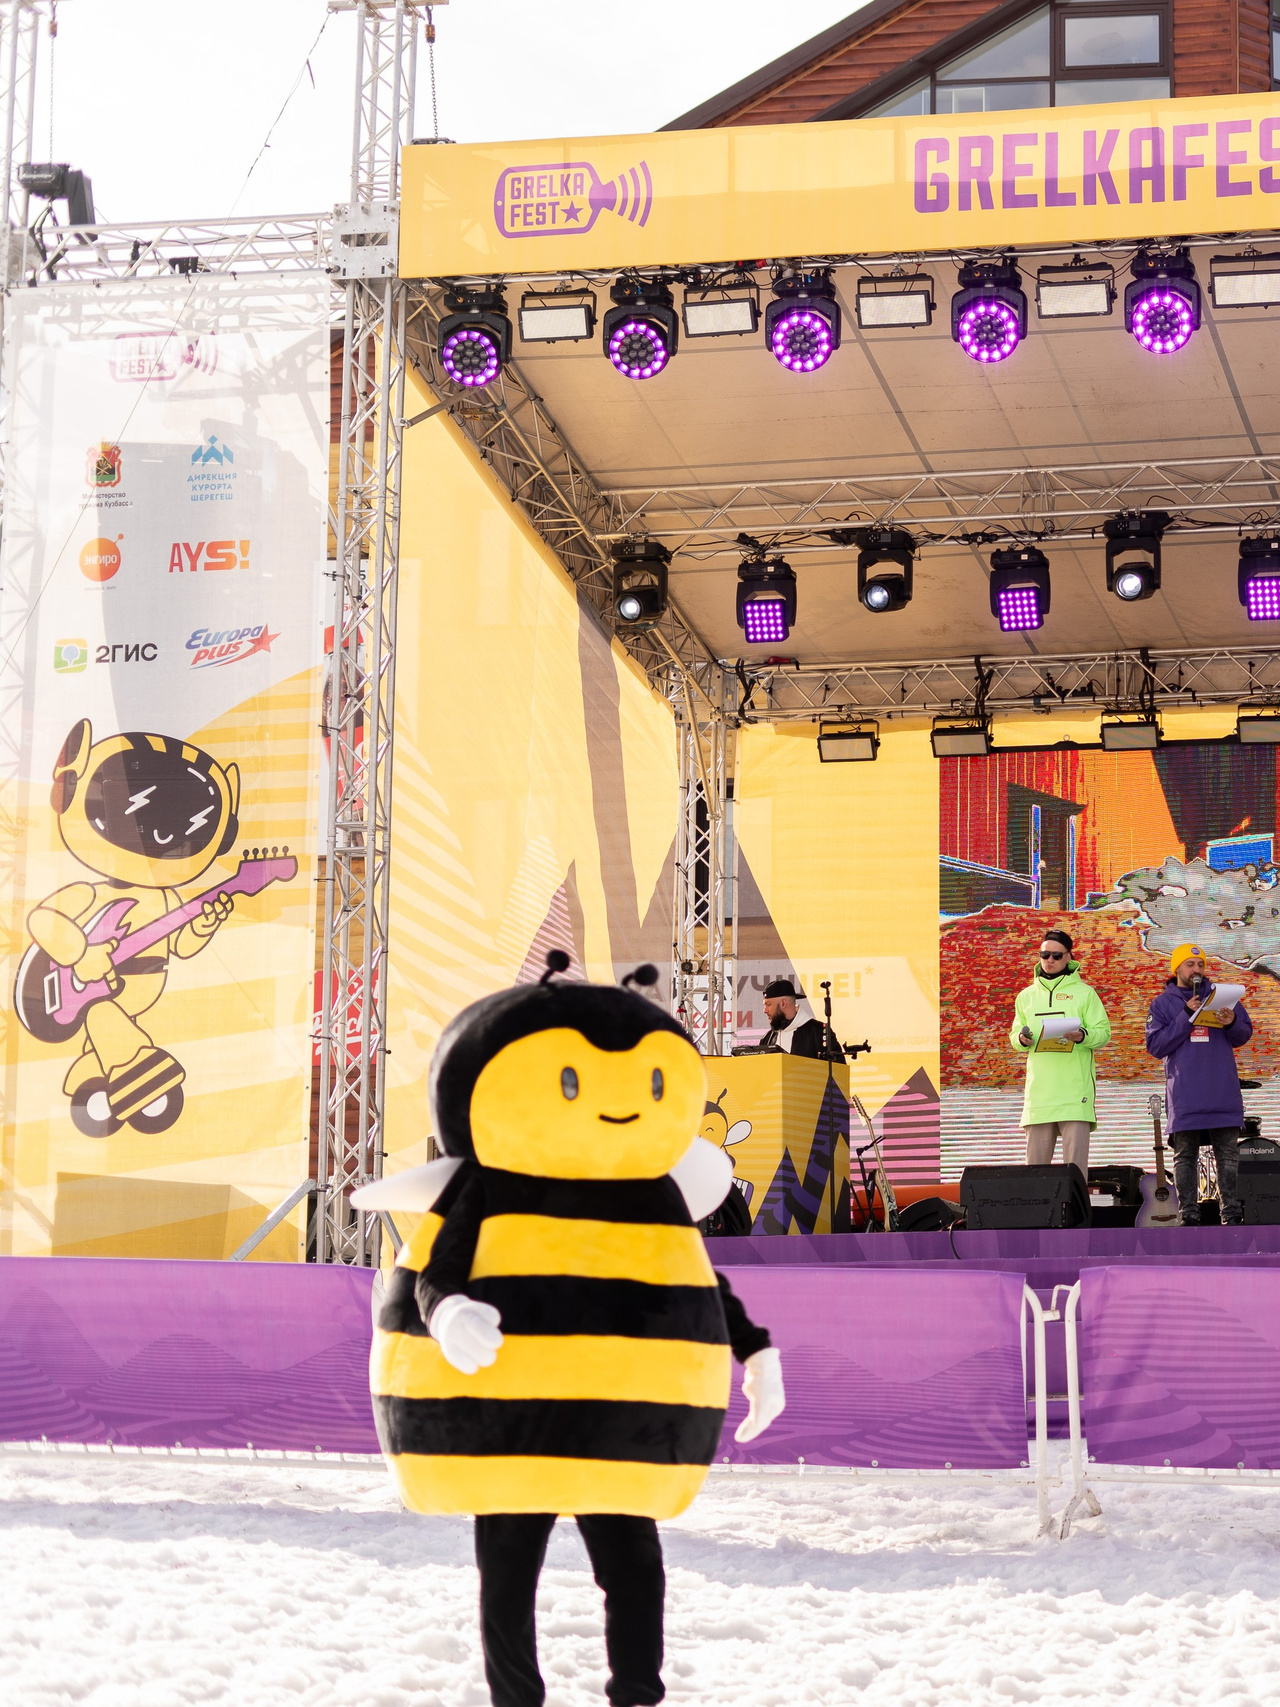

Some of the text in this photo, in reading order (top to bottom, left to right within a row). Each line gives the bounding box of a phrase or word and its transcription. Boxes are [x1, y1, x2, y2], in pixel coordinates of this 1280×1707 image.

[510, 171, 585, 200] GRELKA
[510, 201, 561, 228] FEST
[120, 358, 155, 375] FEST
[186, 472, 237, 482] ДИРЕКЦИЯ
[191, 483, 233, 491] КУРОРТА
[190, 493, 233, 501] ШЕРЕГЕШ
[104, 500, 134, 509] Кузбасса
[83, 554, 117, 567] энгиро
[168, 540, 251, 573] AYS!
[95, 642, 159, 663] 2ГИС
[1249, 1147, 1275, 1155] Roland
